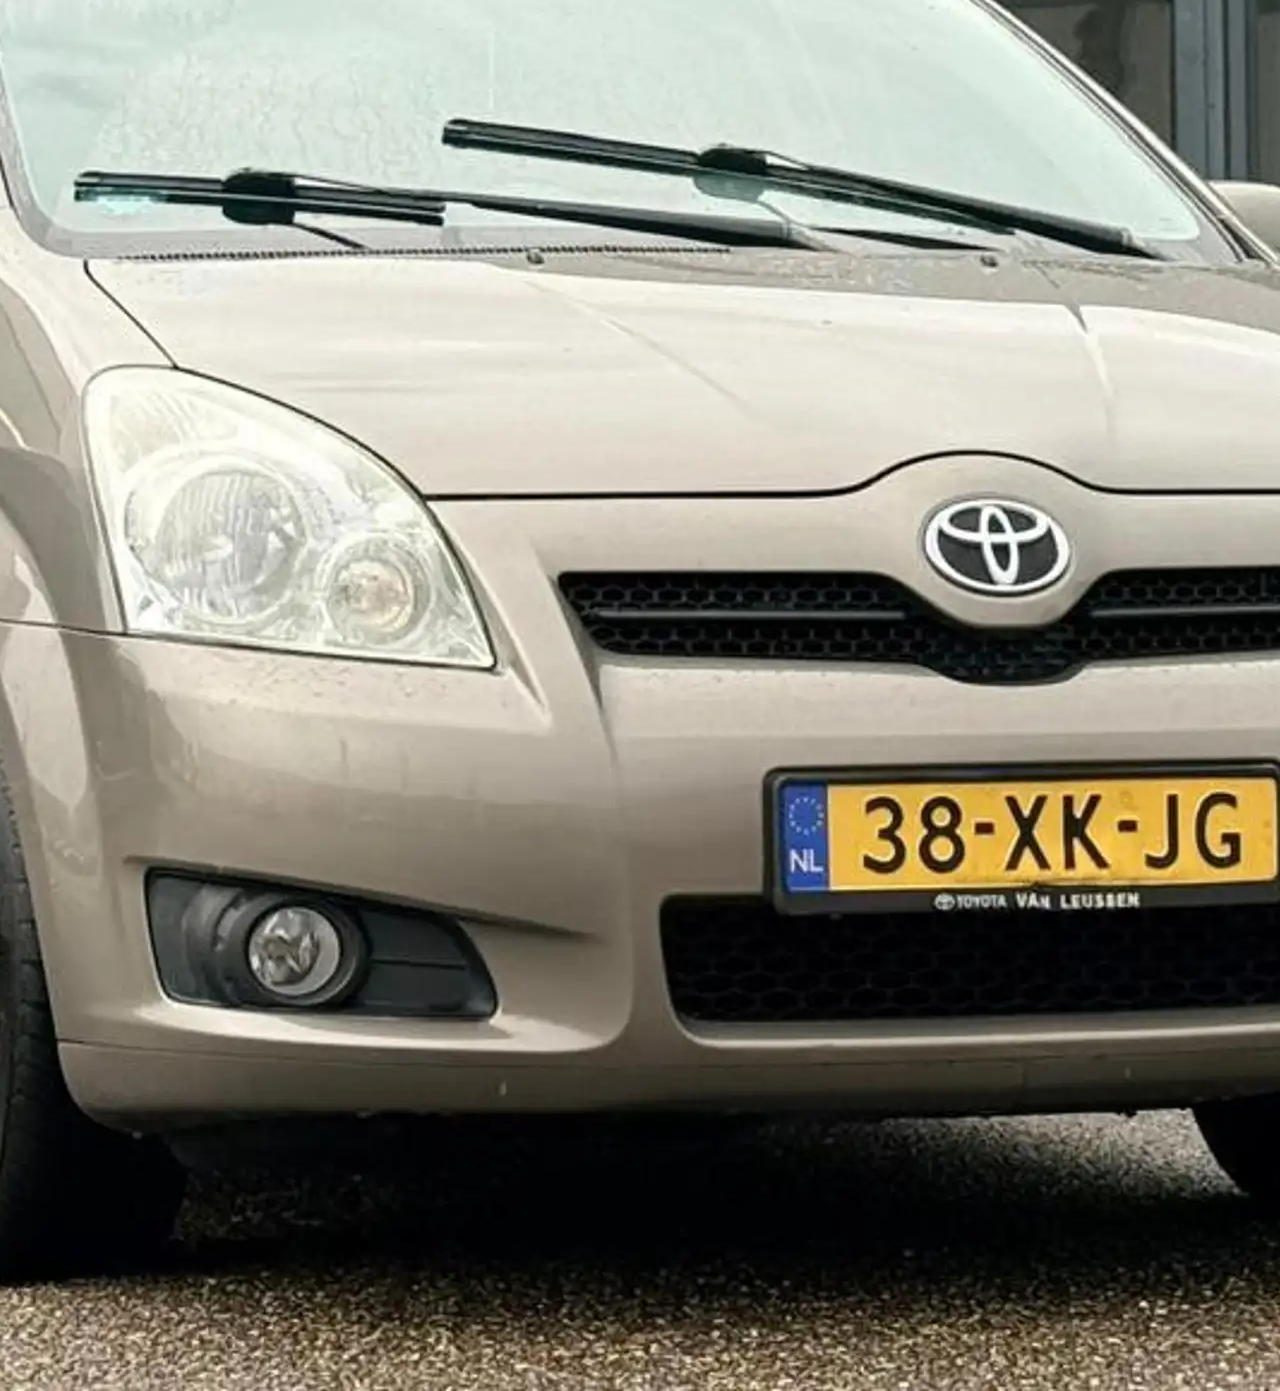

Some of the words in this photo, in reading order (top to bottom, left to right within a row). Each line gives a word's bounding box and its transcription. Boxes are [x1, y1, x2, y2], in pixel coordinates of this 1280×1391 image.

[790, 848, 825, 873] NL
[863, 792, 1242, 874] 38-XK-JG
[956, 894, 1008, 909] TOYOTA
[1059, 892, 1141, 910] LEUSSEN
